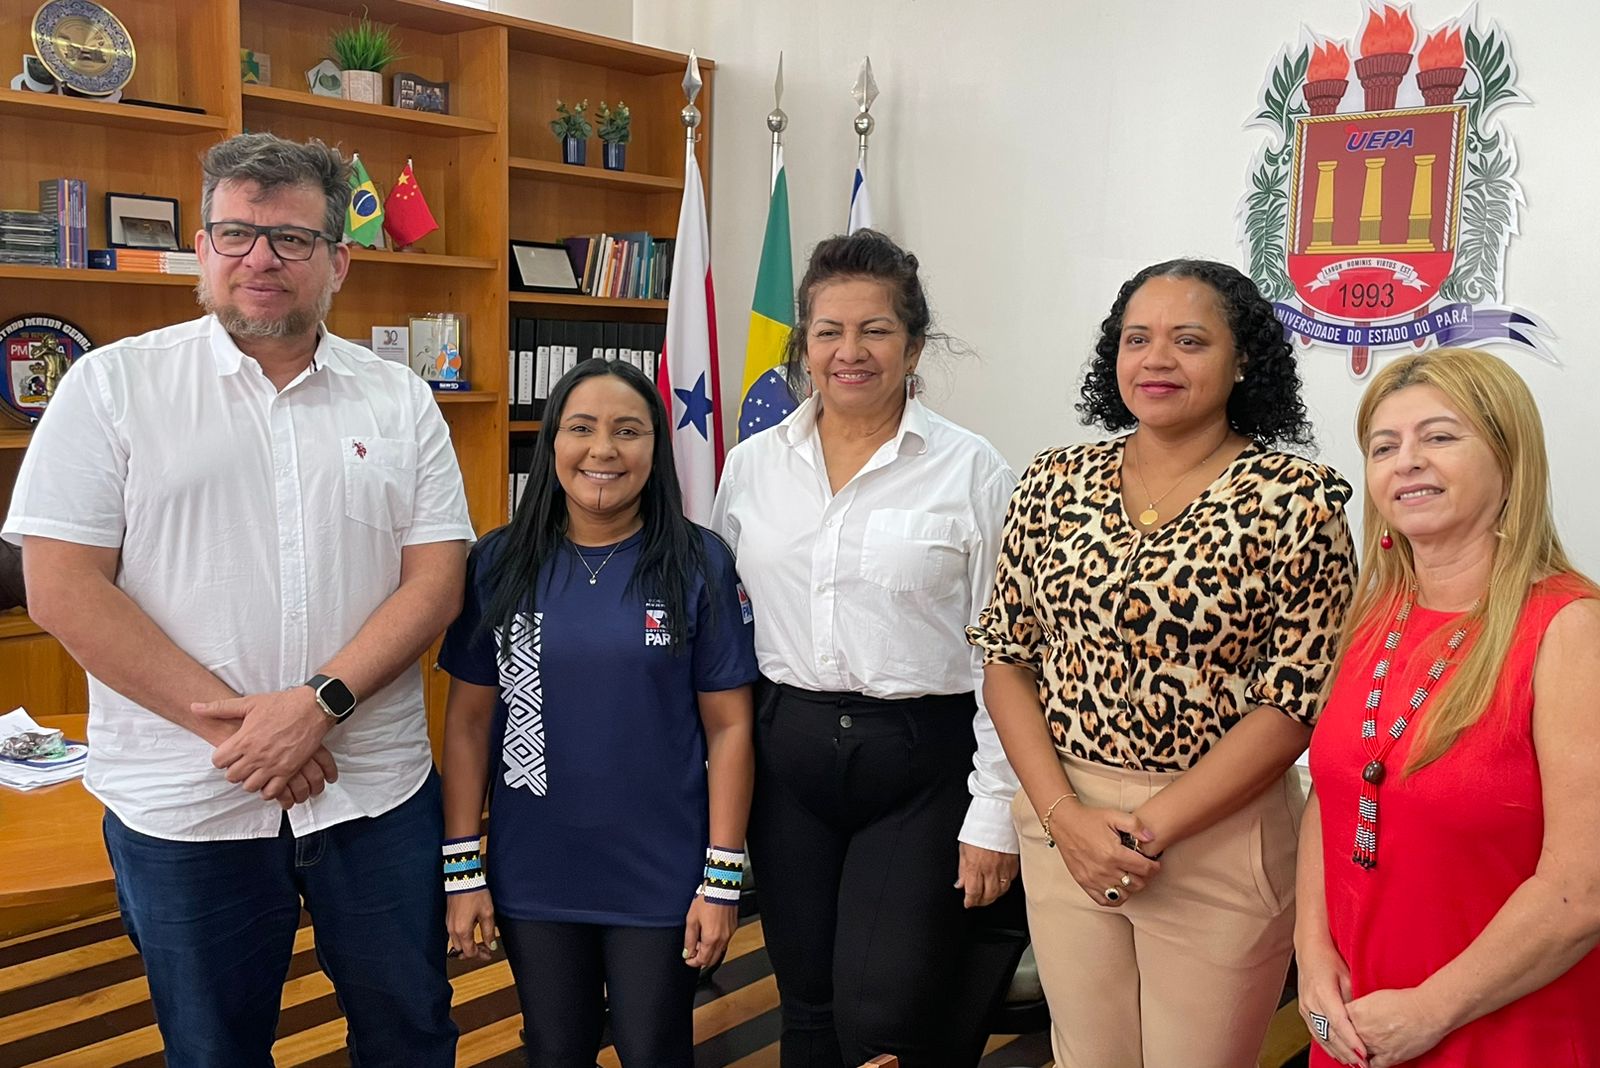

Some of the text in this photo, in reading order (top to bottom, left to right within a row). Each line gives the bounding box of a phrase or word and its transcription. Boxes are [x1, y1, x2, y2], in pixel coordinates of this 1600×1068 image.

[1346, 127, 1415, 152] UEPA
[1346, 259, 1372, 267] HOMINIS
[1376, 260, 1397, 269] VIRTUS
[1400, 265, 1412, 275] EST
[1339, 283, 1394, 308] 1993
[24, 317, 62, 330] MAIOR
[62, 324, 92, 352] GERAL
[1347, 329, 1362, 343] DO
[1368, 326, 1408, 343] ESTADO
[1414, 319, 1430, 336] DO
[11, 345, 28, 356] PM
[645, 632, 671, 646] PAR
